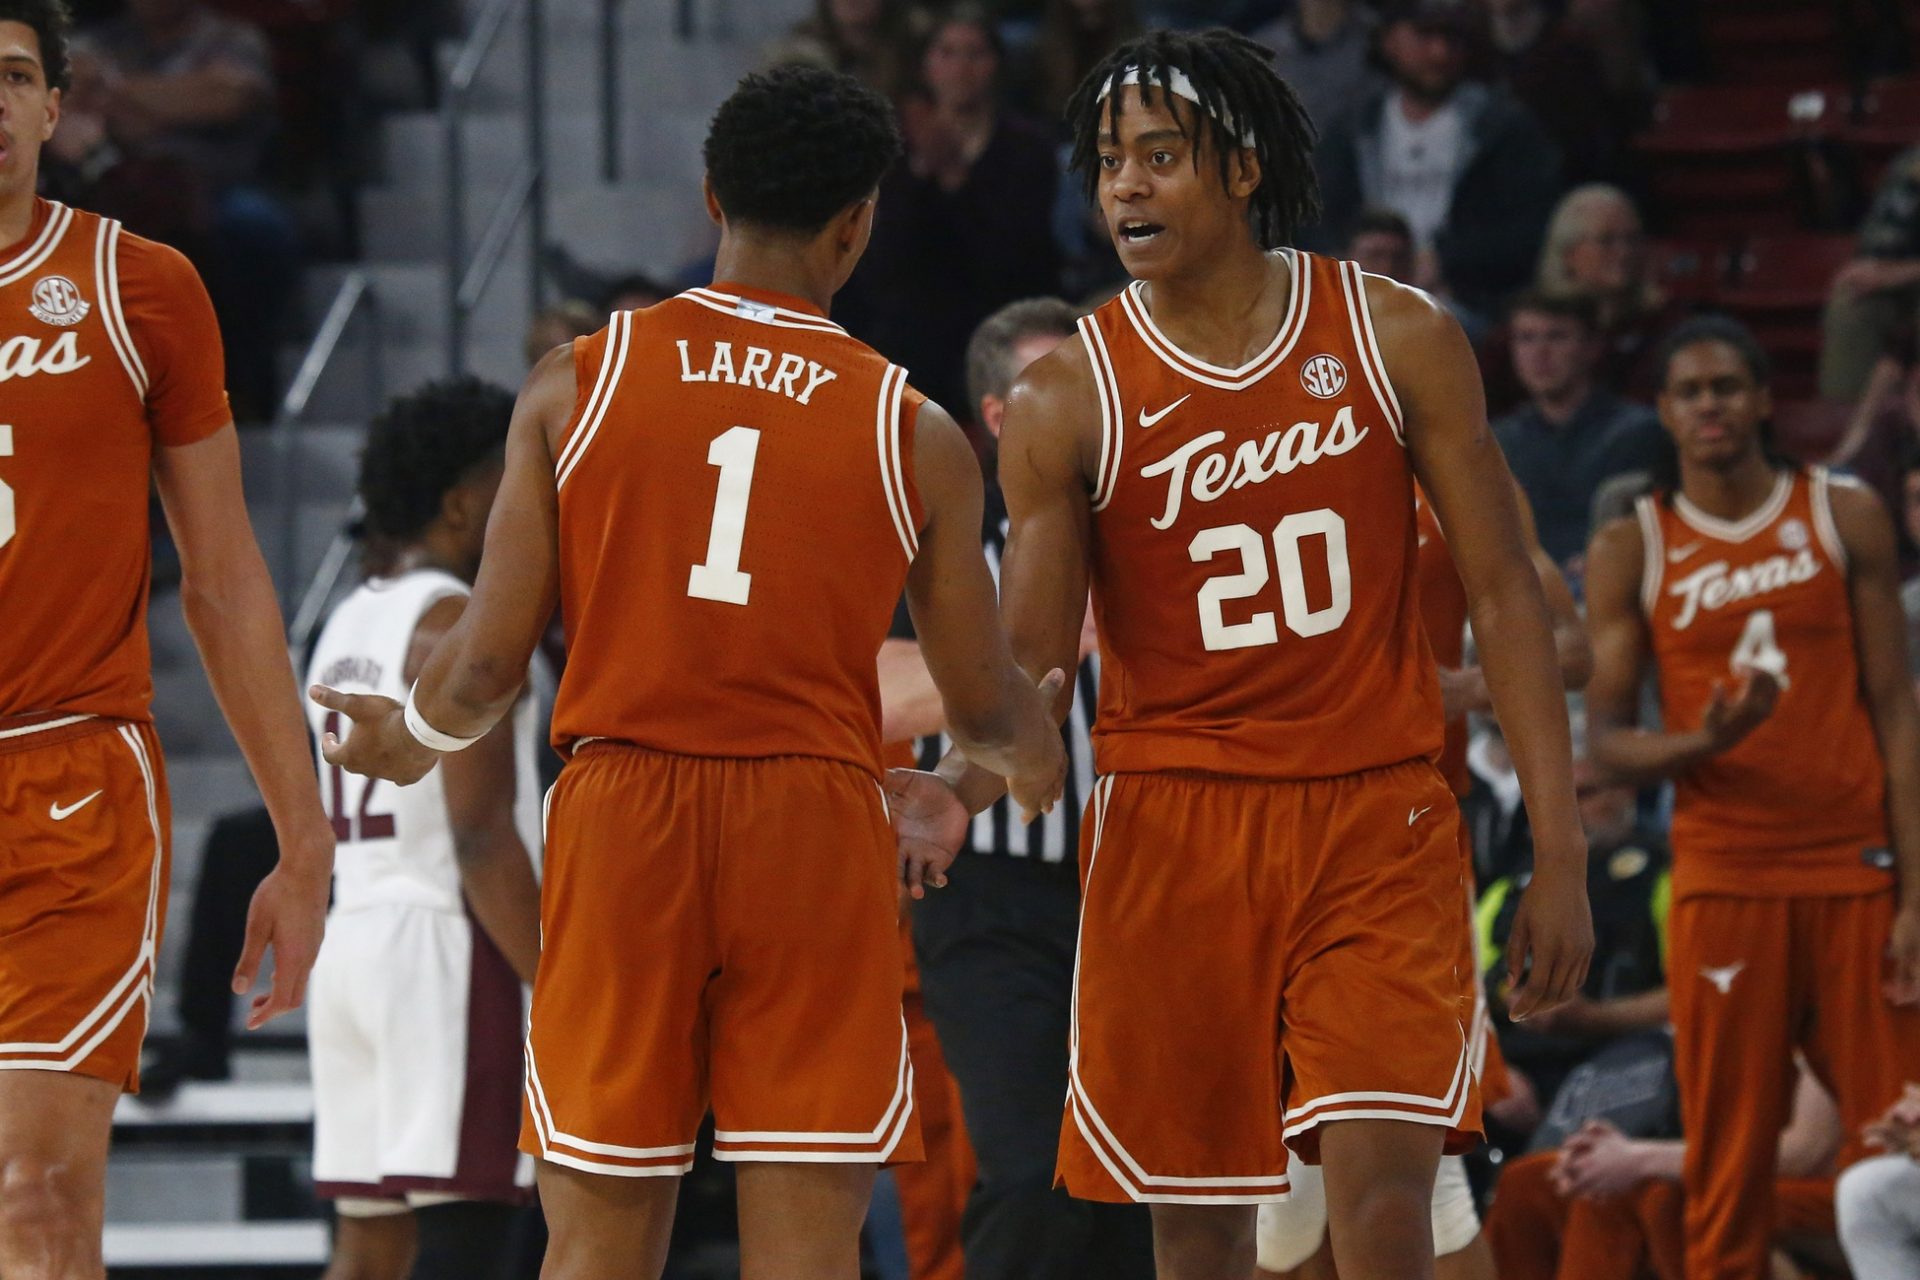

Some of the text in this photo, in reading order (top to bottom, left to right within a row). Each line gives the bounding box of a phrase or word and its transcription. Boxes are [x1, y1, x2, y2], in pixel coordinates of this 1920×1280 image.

[36, 279, 77, 313] SEC
[676, 339, 837, 405] LARRY
[1304, 357, 1344, 396] SEC
[1140, 406, 1369, 530] Texas
[687, 425, 761, 606] 1
[1188, 507, 1351, 651] 20
[1668, 549, 1822, 630] Texas
[1729, 609, 1790, 691] 4
